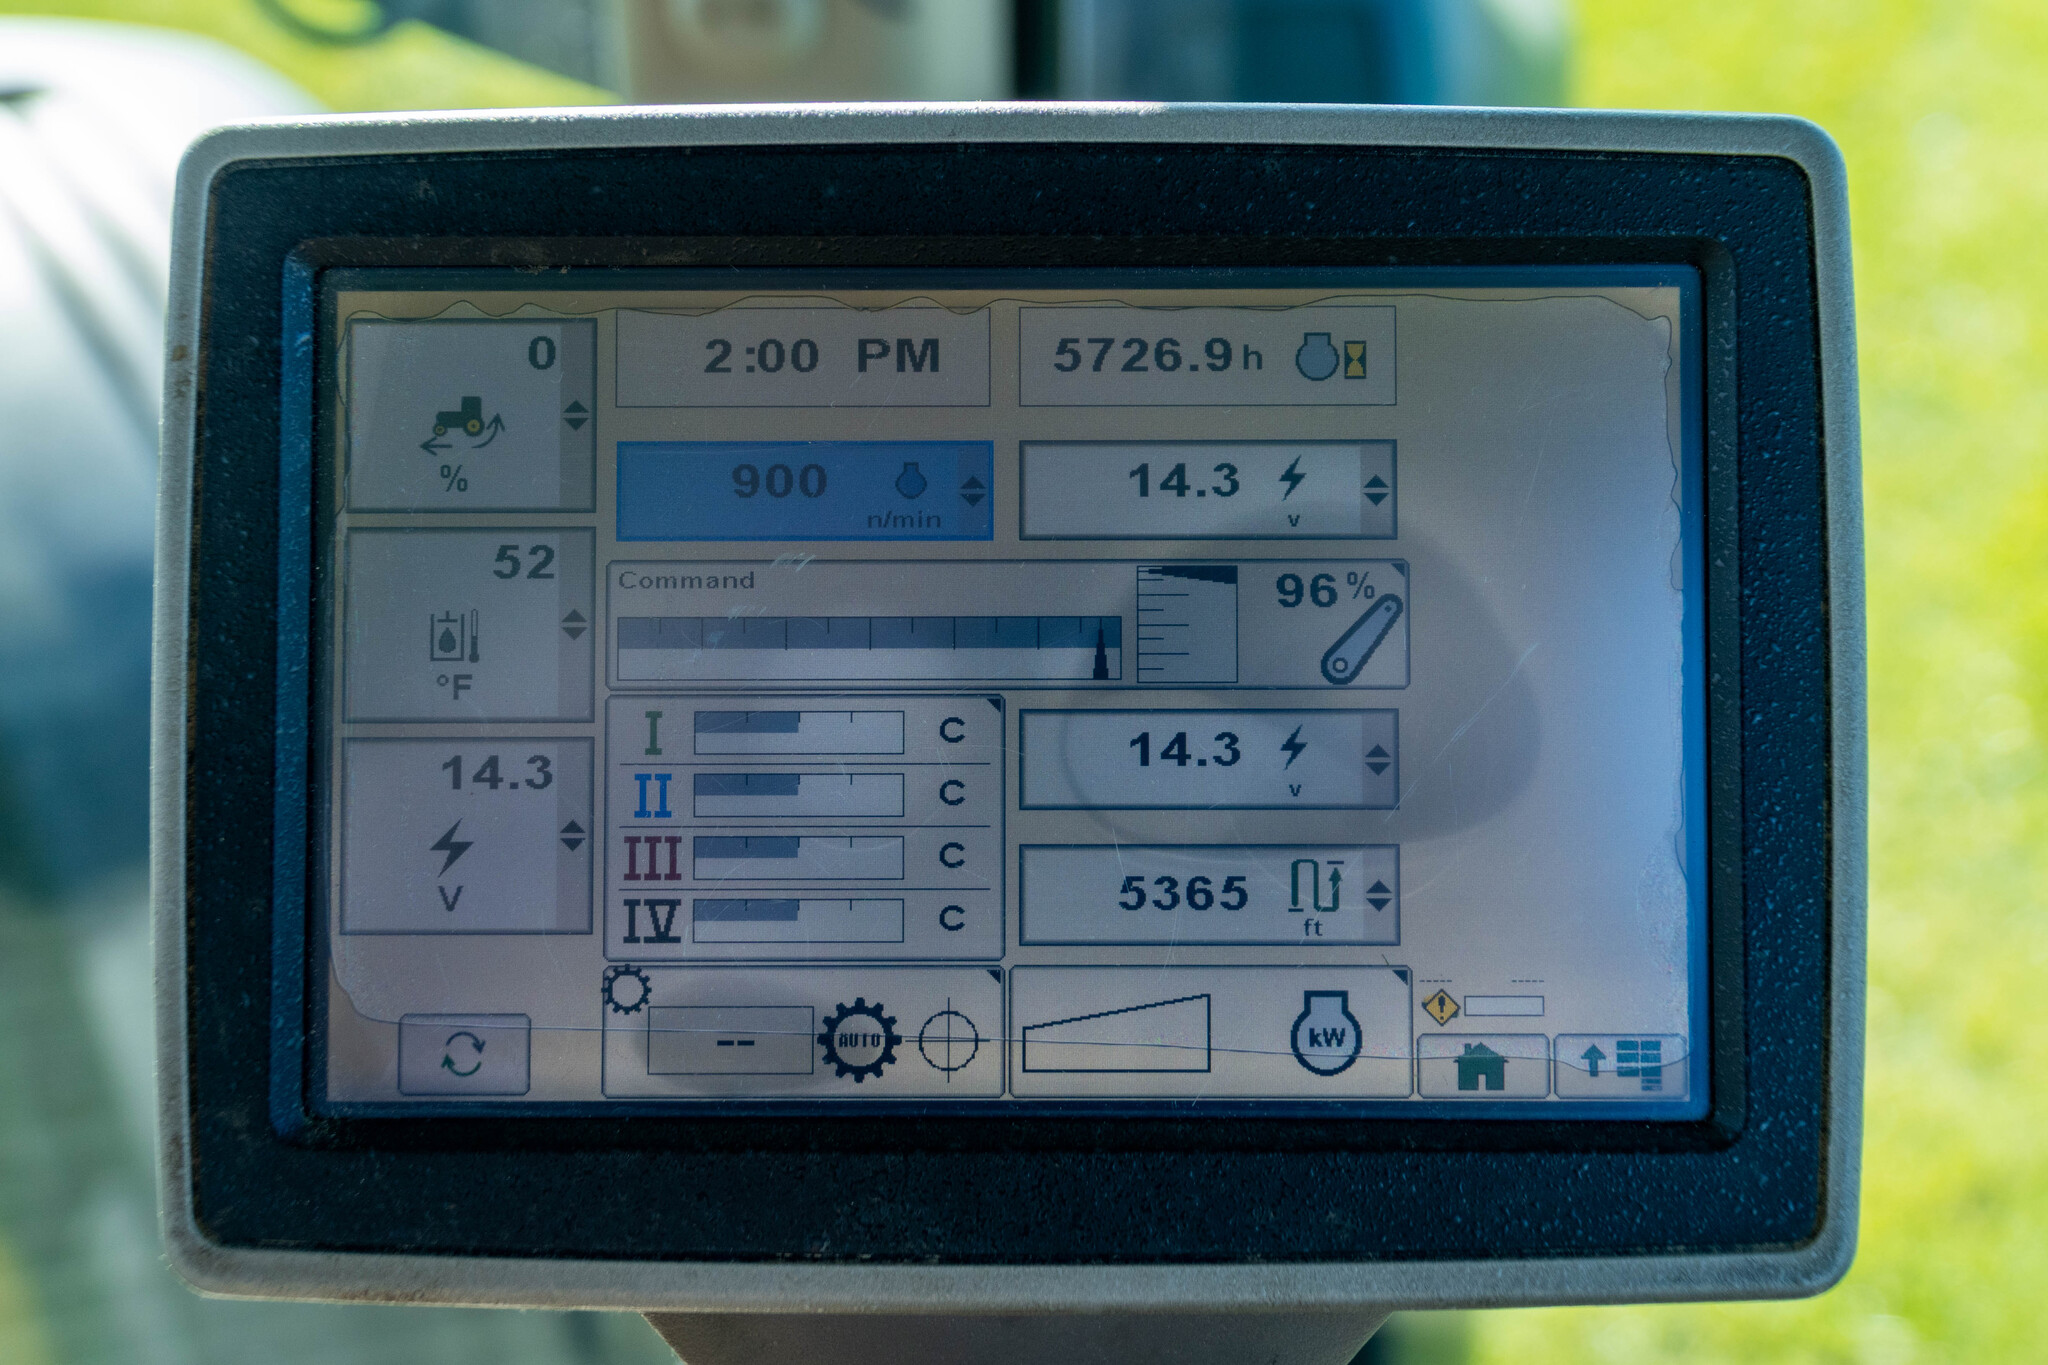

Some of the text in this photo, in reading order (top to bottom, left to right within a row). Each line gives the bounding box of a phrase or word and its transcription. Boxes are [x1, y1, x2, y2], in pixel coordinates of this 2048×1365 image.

[528, 337, 556, 370] 0
[704, 338, 940, 373] 2:00 PM
[1054, 338, 1262, 372] 5726.9 h
[440, 464, 469, 492] %
[732, 464, 827, 499] 900
[1129, 464, 1240, 497] 14.3
[867, 511, 942, 529] n/min
[493, 545, 555, 579] 52
[619, 571, 755, 590] Command
[1276, 571, 1375, 607] 96 %
[436, 674, 472, 699] °F
[644, 711, 662, 755] I
[939, 717, 965, 743] C
[1129, 732, 1241, 767] 14.3
[441, 755, 553, 790] 14.3
[634, 774, 672, 817] II
[939, 780, 965, 805] C
[624, 836, 682, 880] III
[939, 842, 965, 868] C
[438, 886, 463, 911] V
[1119, 876, 1248, 911] 5365
[623, 899, 681, 943] IV
[939, 905, 965, 931] C
[1304, 918, 1323, 936] ft
[838, 1034, 881, 1047] AUTO
[1309, 1027, 1347, 1047] kW
